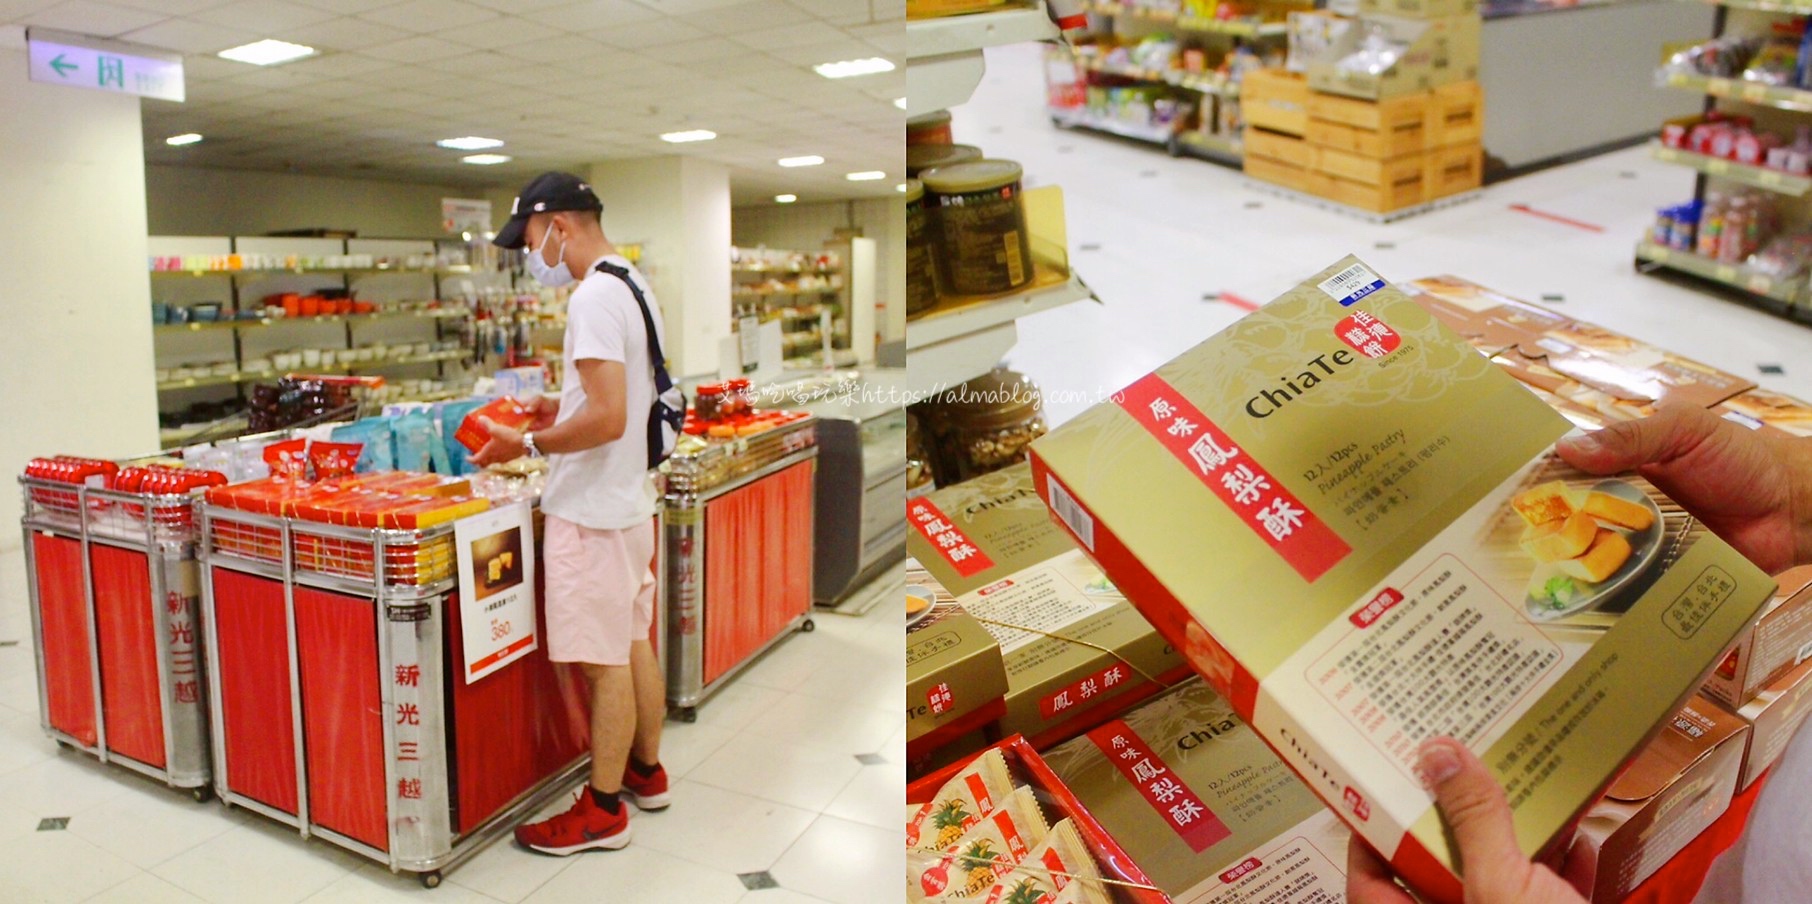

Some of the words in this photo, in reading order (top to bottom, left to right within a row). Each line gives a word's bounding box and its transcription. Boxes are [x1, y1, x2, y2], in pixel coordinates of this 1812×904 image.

[1245, 349, 1355, 419] ChiaTe
[1317, 451, 1373, 495] Pineapple
[1371, 429, 1406, 456] Pastry
[1053, 667, 1122, 713] 鳳梨酥
[1539, 711, 1557, 731] The
[1556, 699, 1571, 717] one
[1571, 682, 1586, 703] and
[1585, 669, 1602, 690] only
[1600, 652, 1619, 671] shop
[395, 664, 422, 800] 新光三越
[1111, 734, 1204, 827] 原味鳳梨酥
